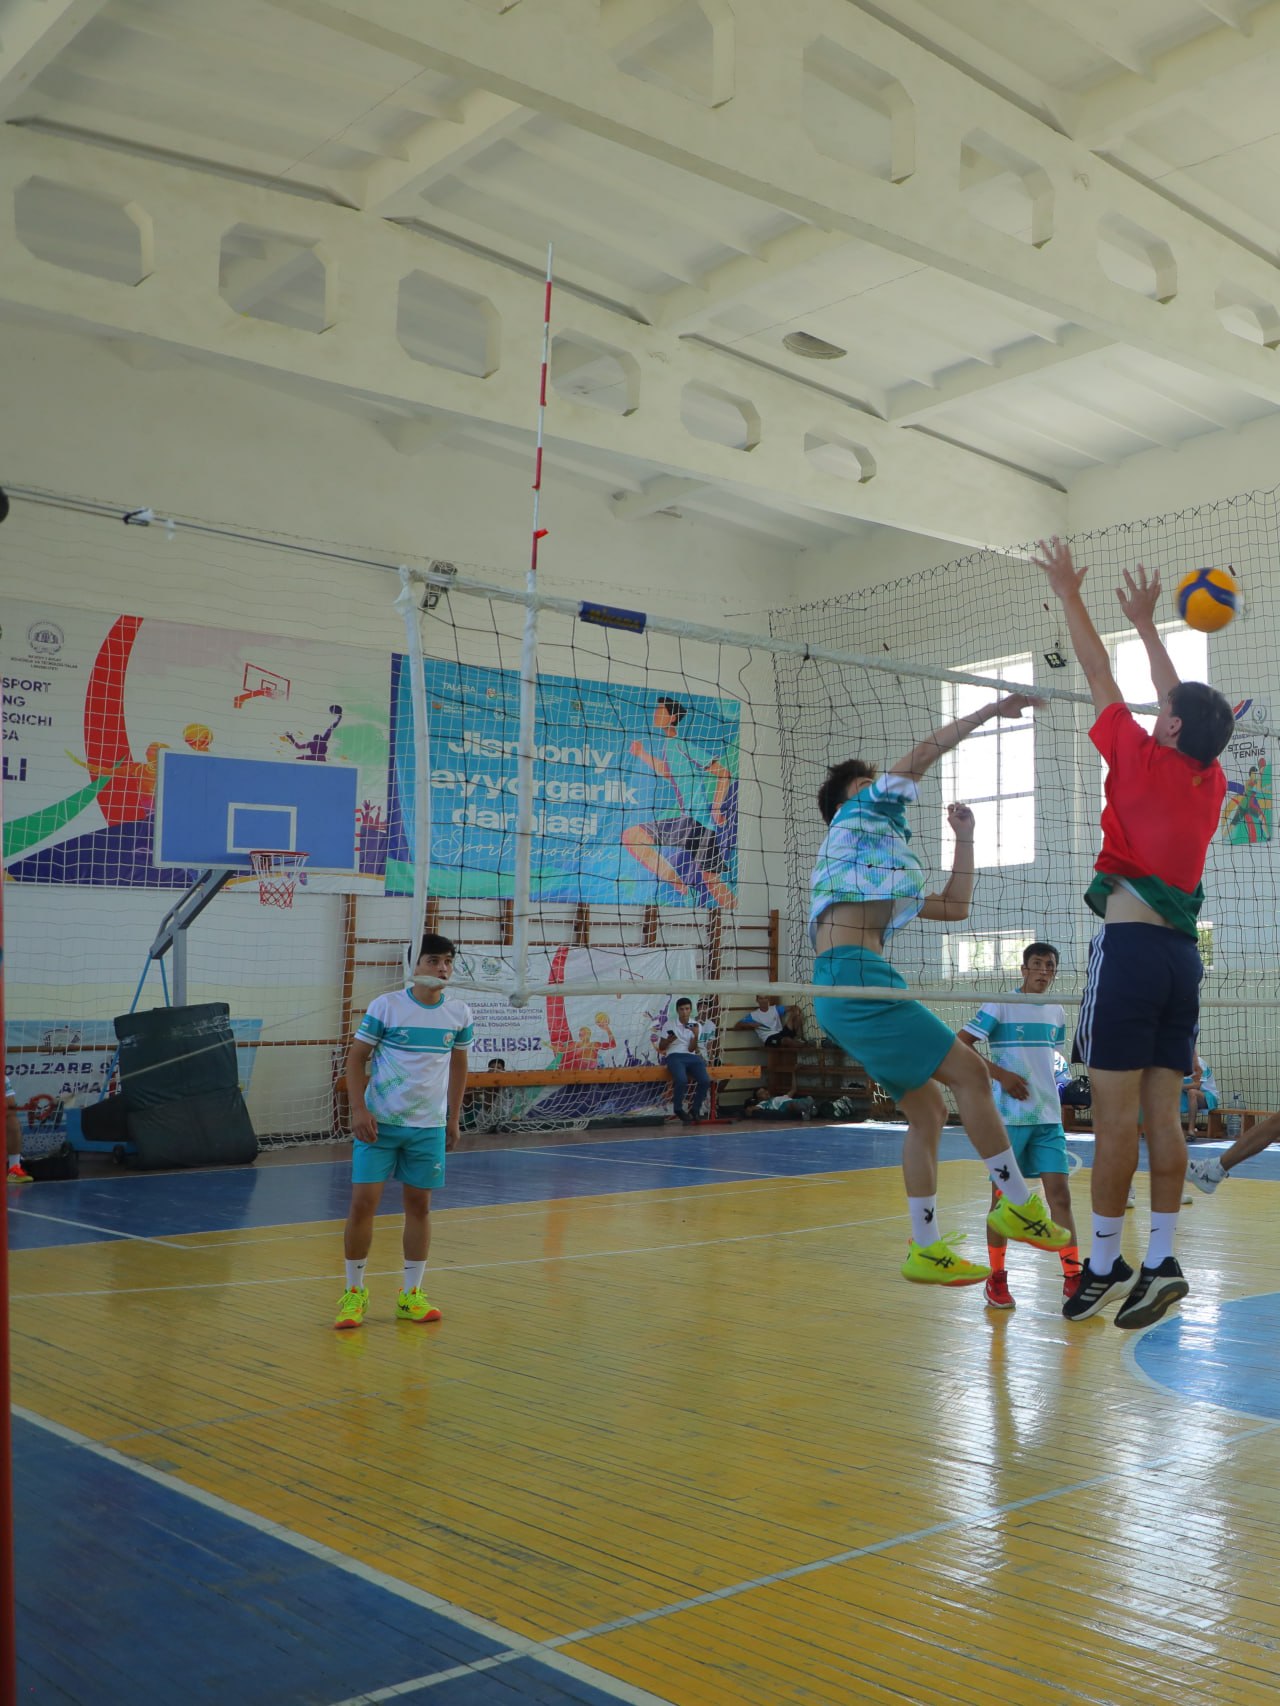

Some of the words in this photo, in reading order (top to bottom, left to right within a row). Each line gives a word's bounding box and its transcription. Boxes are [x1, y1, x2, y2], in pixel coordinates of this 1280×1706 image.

[2, 677, 51, 693] SPORT
[1233, 747, 1266, 759] TENNIS
[431, 829, 513, 865] Sport
[472, 1037, 542, 1053] KELIBSIZ
